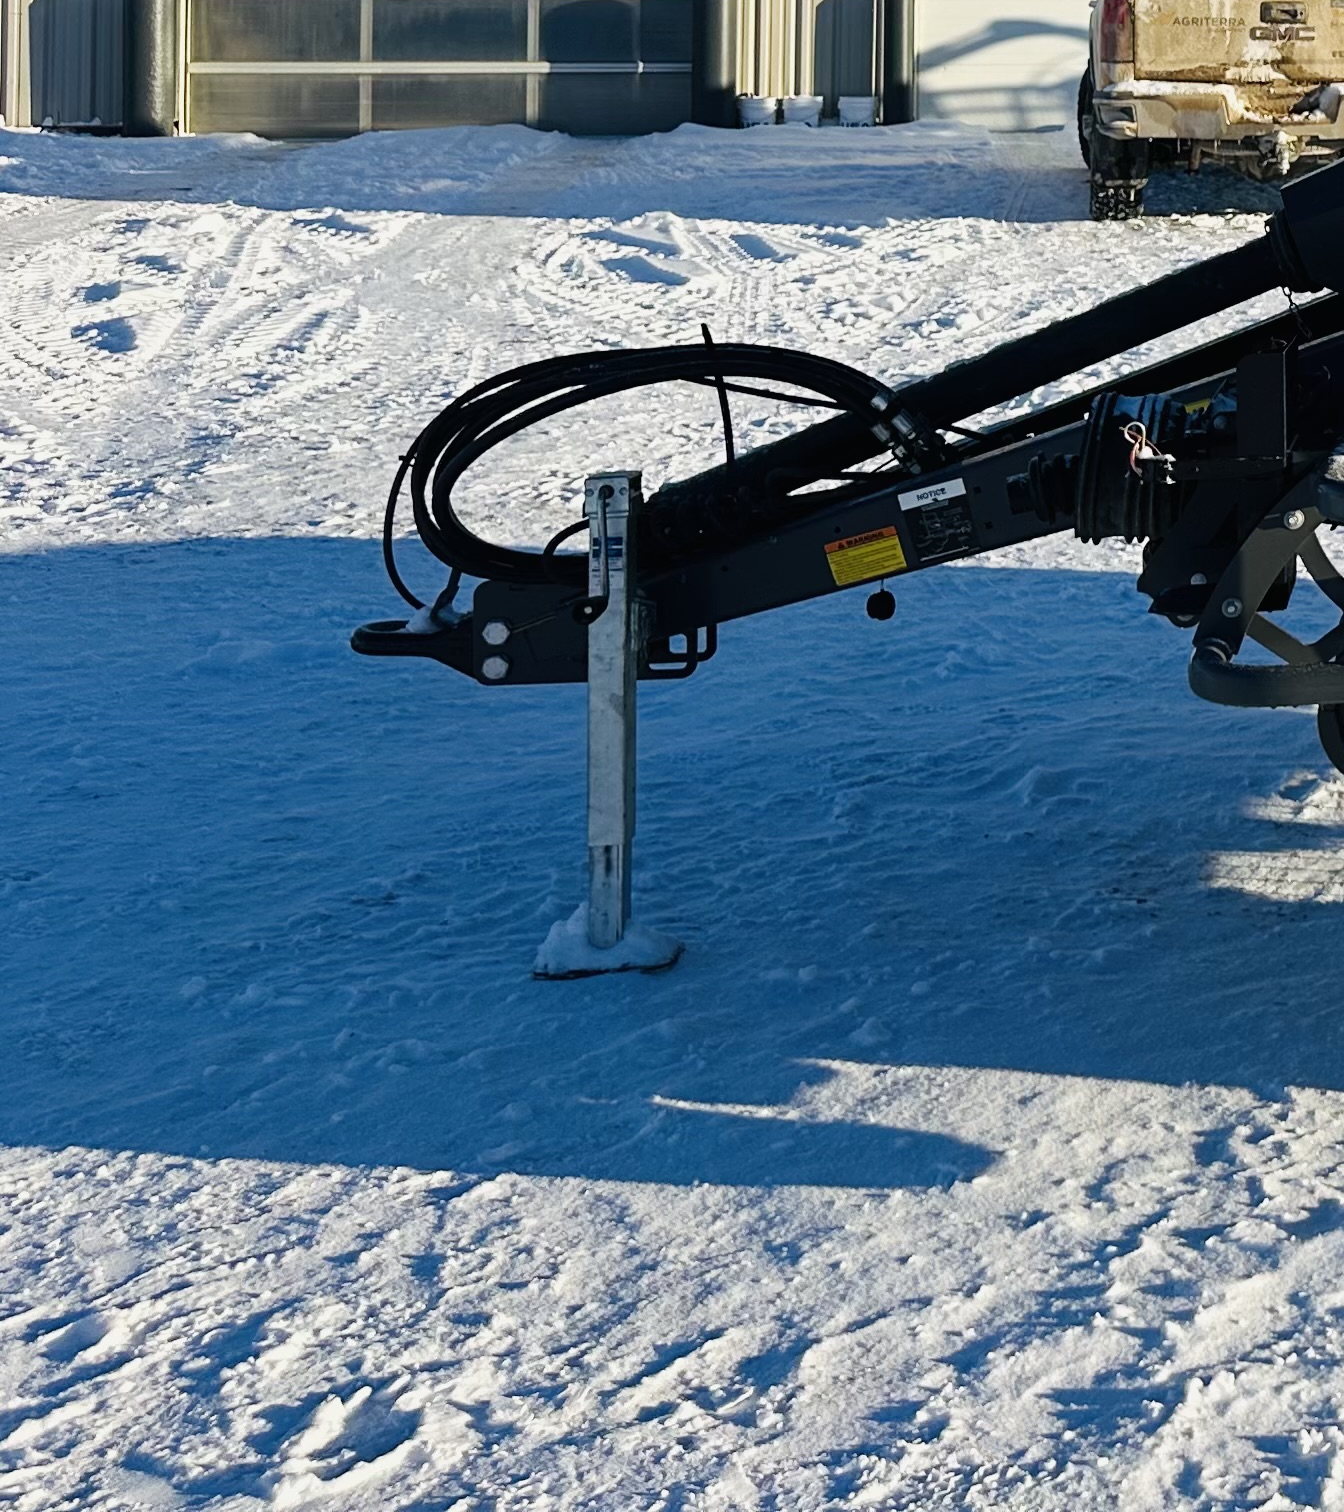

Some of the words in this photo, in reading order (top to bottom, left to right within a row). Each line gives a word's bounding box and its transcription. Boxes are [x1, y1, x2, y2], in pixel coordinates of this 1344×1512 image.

[1173, 16, 1246, 27] AGRITERRA
[1250, 26, 1316, 41] GMC
[917, 487, 947, 502] NOTICE
[849, 531, 885, 548] WARNING
